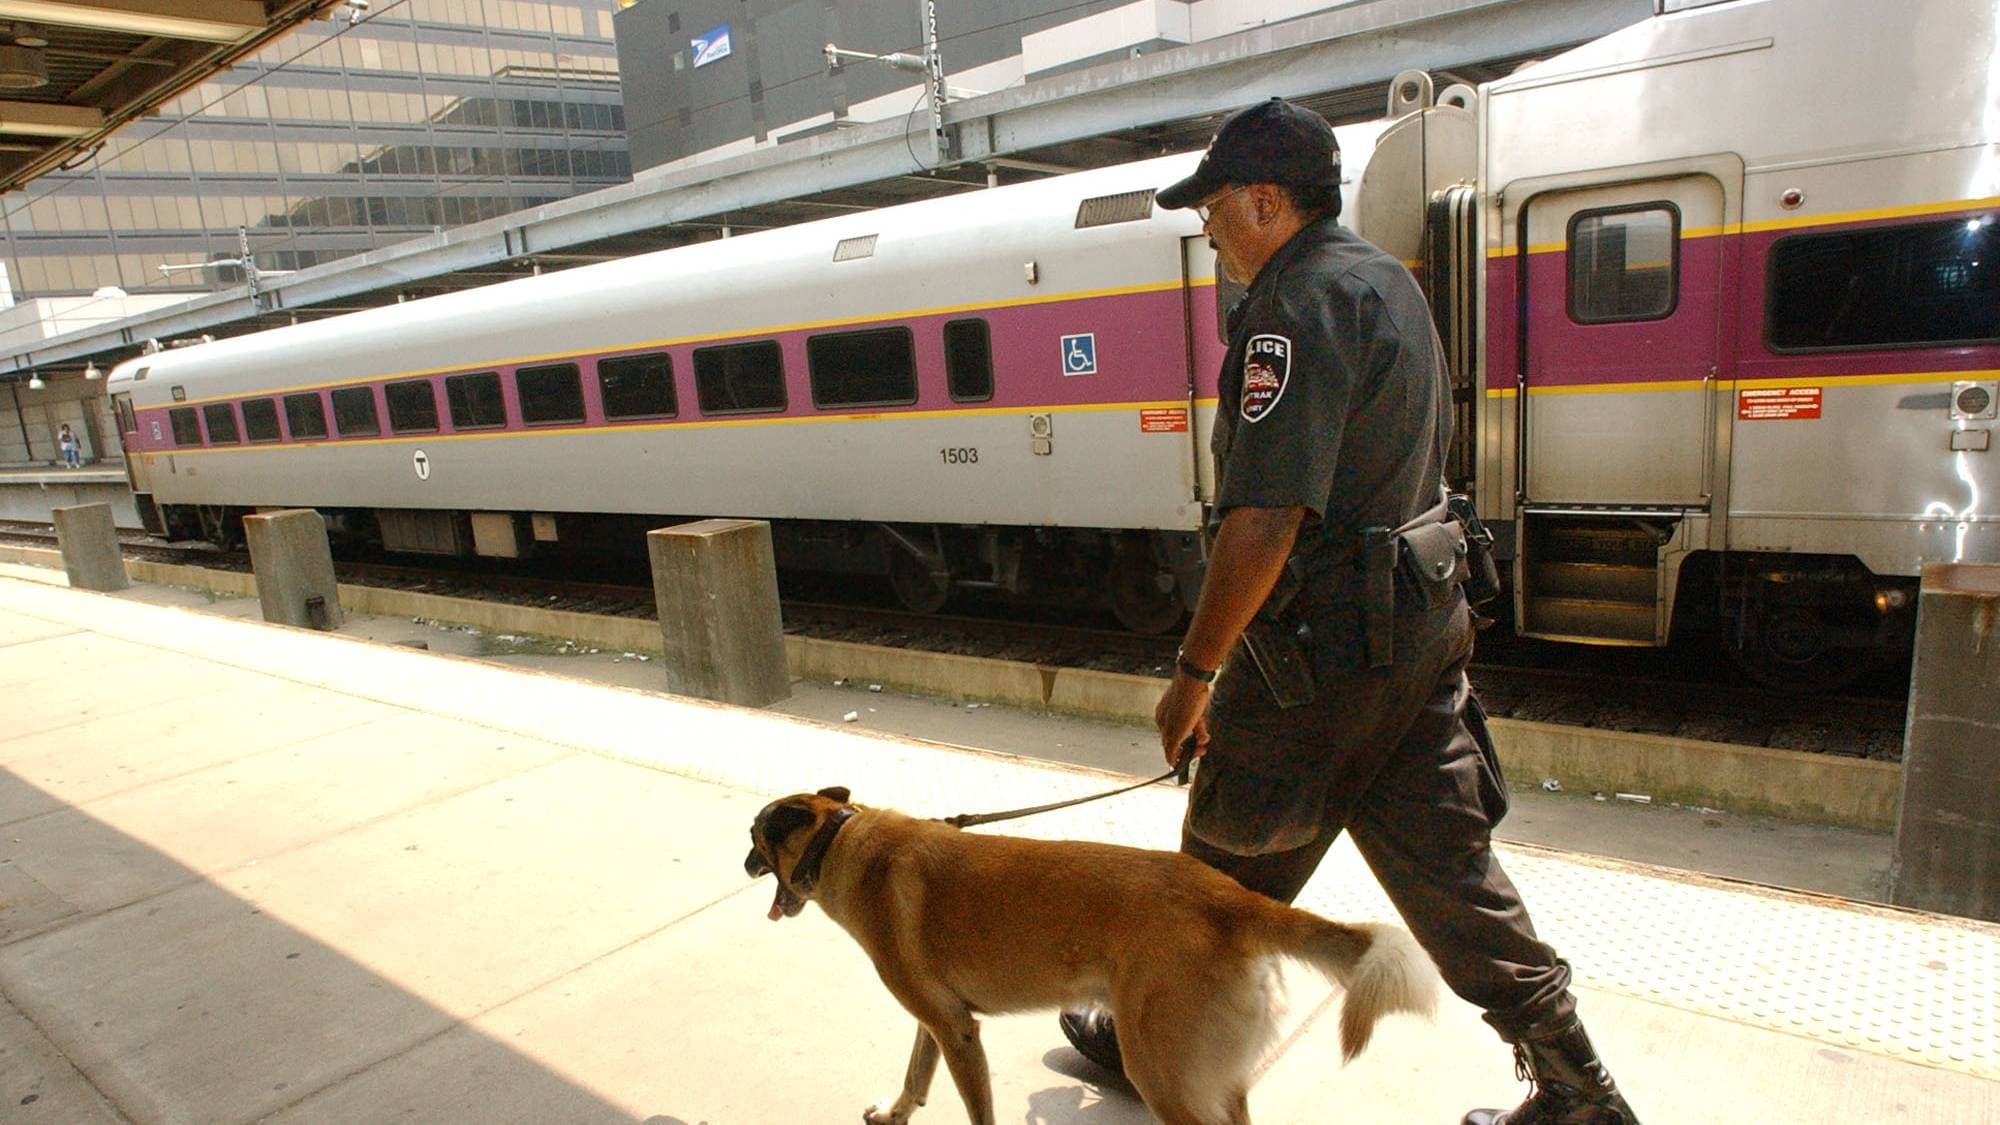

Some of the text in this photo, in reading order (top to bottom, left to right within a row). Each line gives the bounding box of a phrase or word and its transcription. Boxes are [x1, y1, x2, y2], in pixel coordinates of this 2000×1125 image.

[1249, 341, 1285, 357] LICE
[1248, 391, 1272, 399] TRAK
[940, 447, 978, 464] 1503
[415, 457, 426, 475] T
